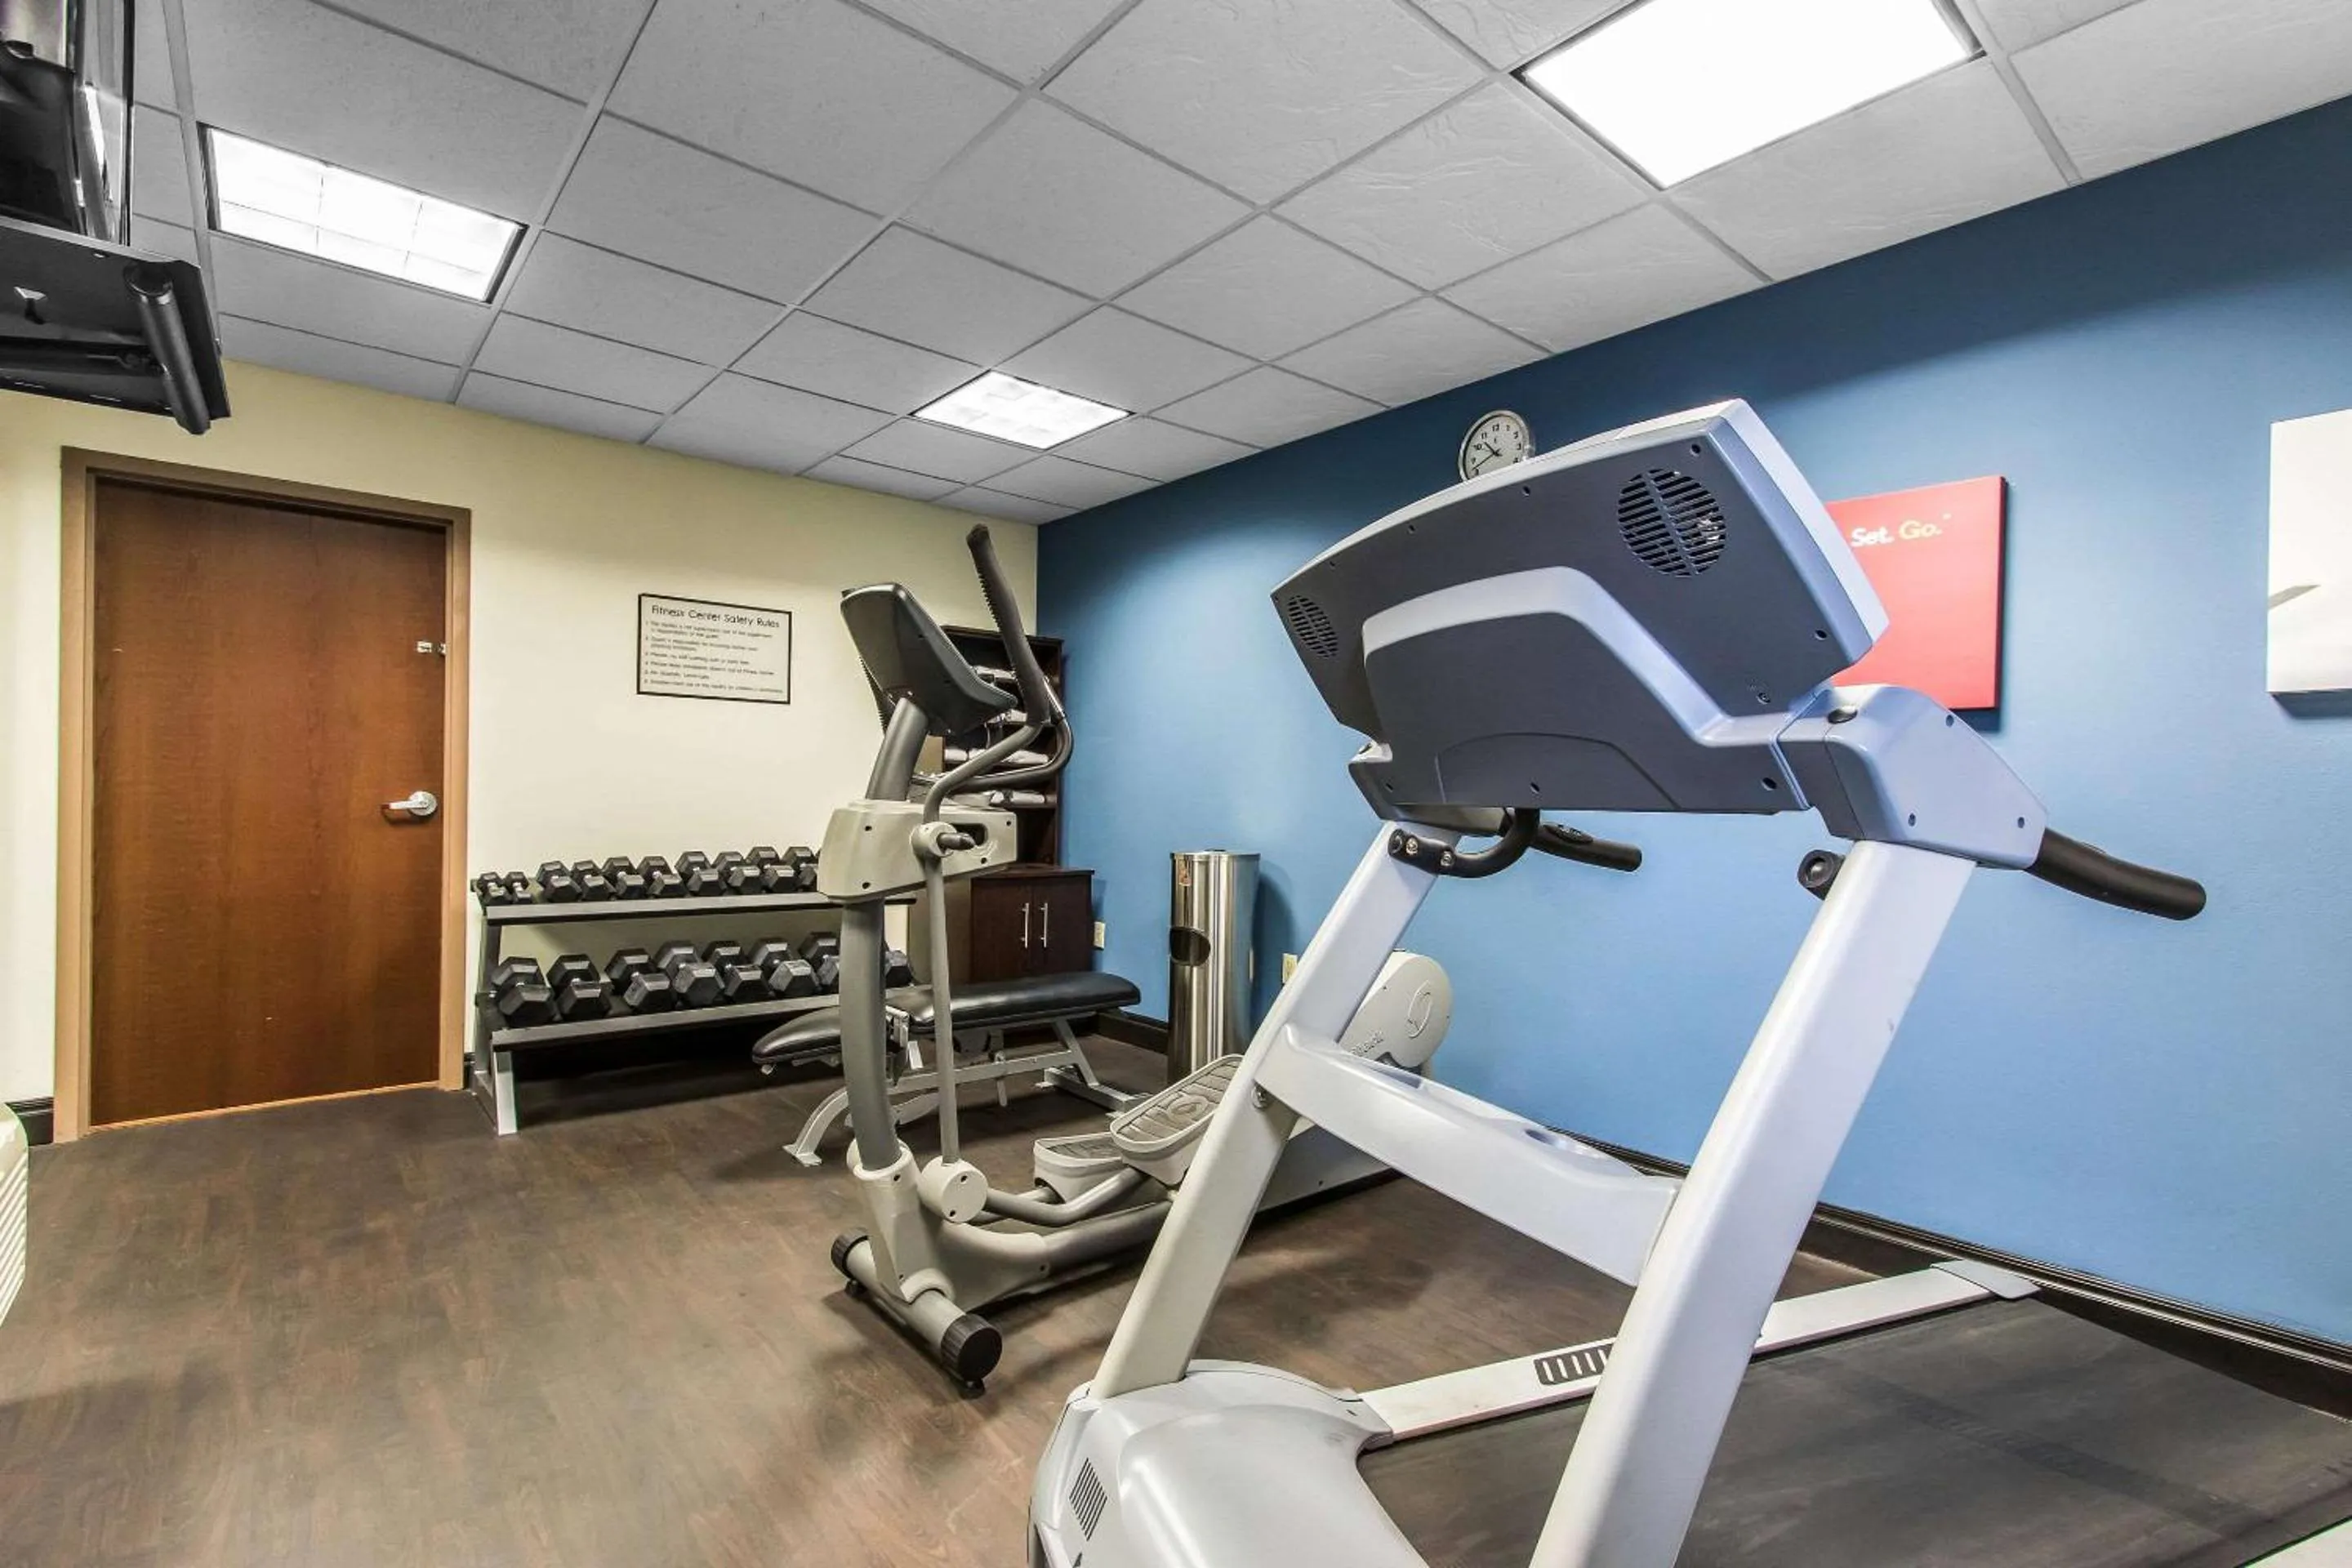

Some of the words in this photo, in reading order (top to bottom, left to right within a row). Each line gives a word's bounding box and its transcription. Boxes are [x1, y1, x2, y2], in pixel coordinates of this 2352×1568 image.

[1851, 525, 1895, 547] Set.
[1899, 519, 1943, 540] Go.
[651, 604, 684, 617] Fitness
[688, 609, 720, 621] Center
[724, 614, 754, 627] Safety
[756, 617, 780, 628] Rules
